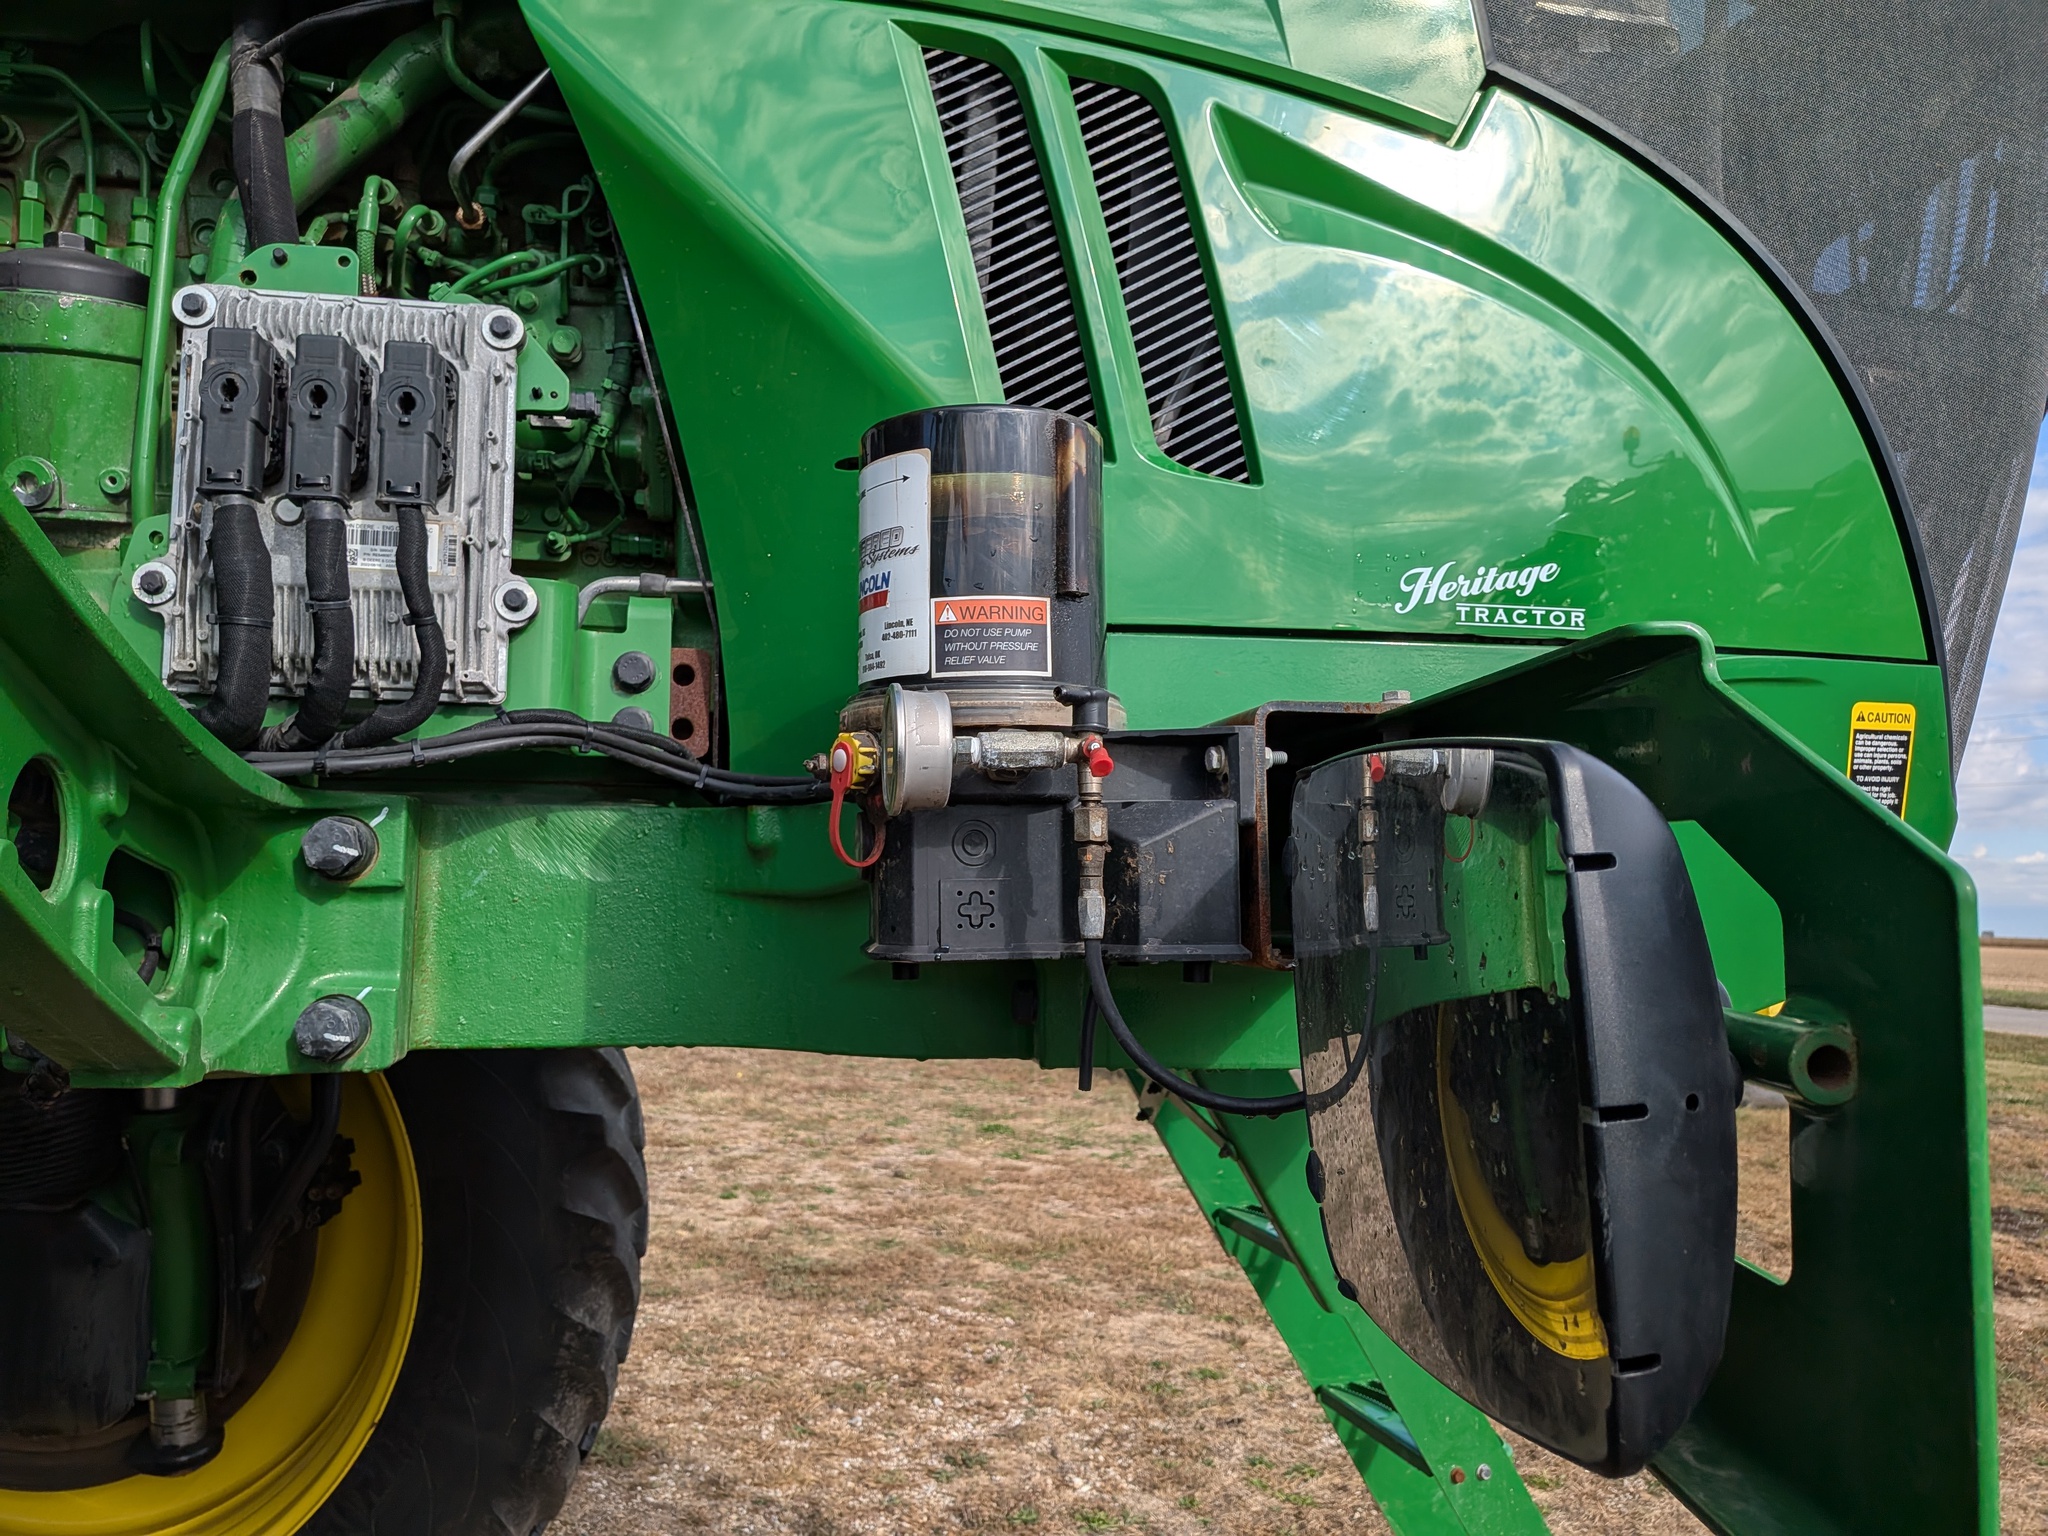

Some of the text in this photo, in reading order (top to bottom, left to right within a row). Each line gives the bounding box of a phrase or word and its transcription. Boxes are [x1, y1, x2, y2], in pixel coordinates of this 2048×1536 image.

[867, 545, 920, 568] Systems
[1394, 560, 1560, 614] Heritage
[959, 606, 1044, 621] WARNING
[1456, 606, 1585, 627] TRACTOR
[884, 618, 913, 630] Lincoln, NE
[944, 628, 1032, 638] DO NOT USE PUMP
[944, 642, 1039, 651] WITHOUT PRESSURE
[944, 655, 1006, 665] RELIEF VALVE
[1867, 712, 1910, 724] CAUTION
